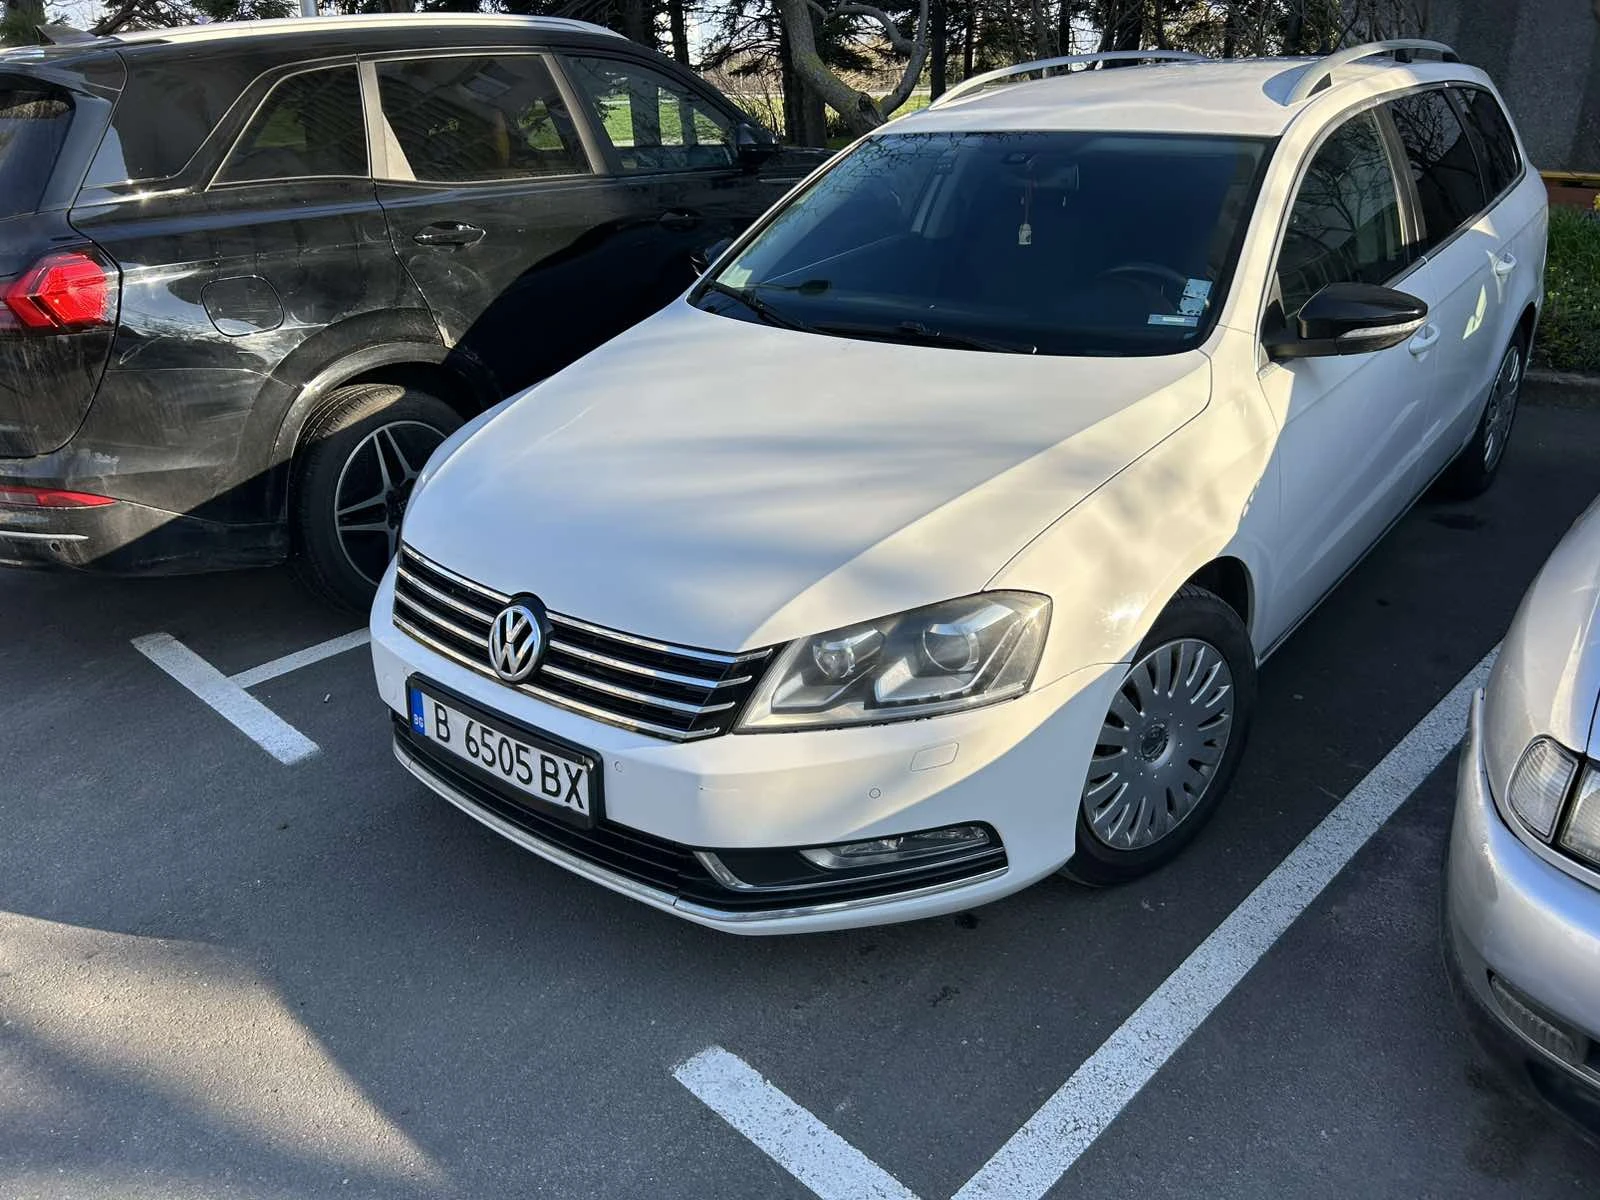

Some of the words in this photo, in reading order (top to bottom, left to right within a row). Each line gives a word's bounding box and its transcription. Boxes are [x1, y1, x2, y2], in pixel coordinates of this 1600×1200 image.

[434, 702, 450, 743] B
[465, 721, 533, 785] 6505
[540, 754, 585, 810] BX
